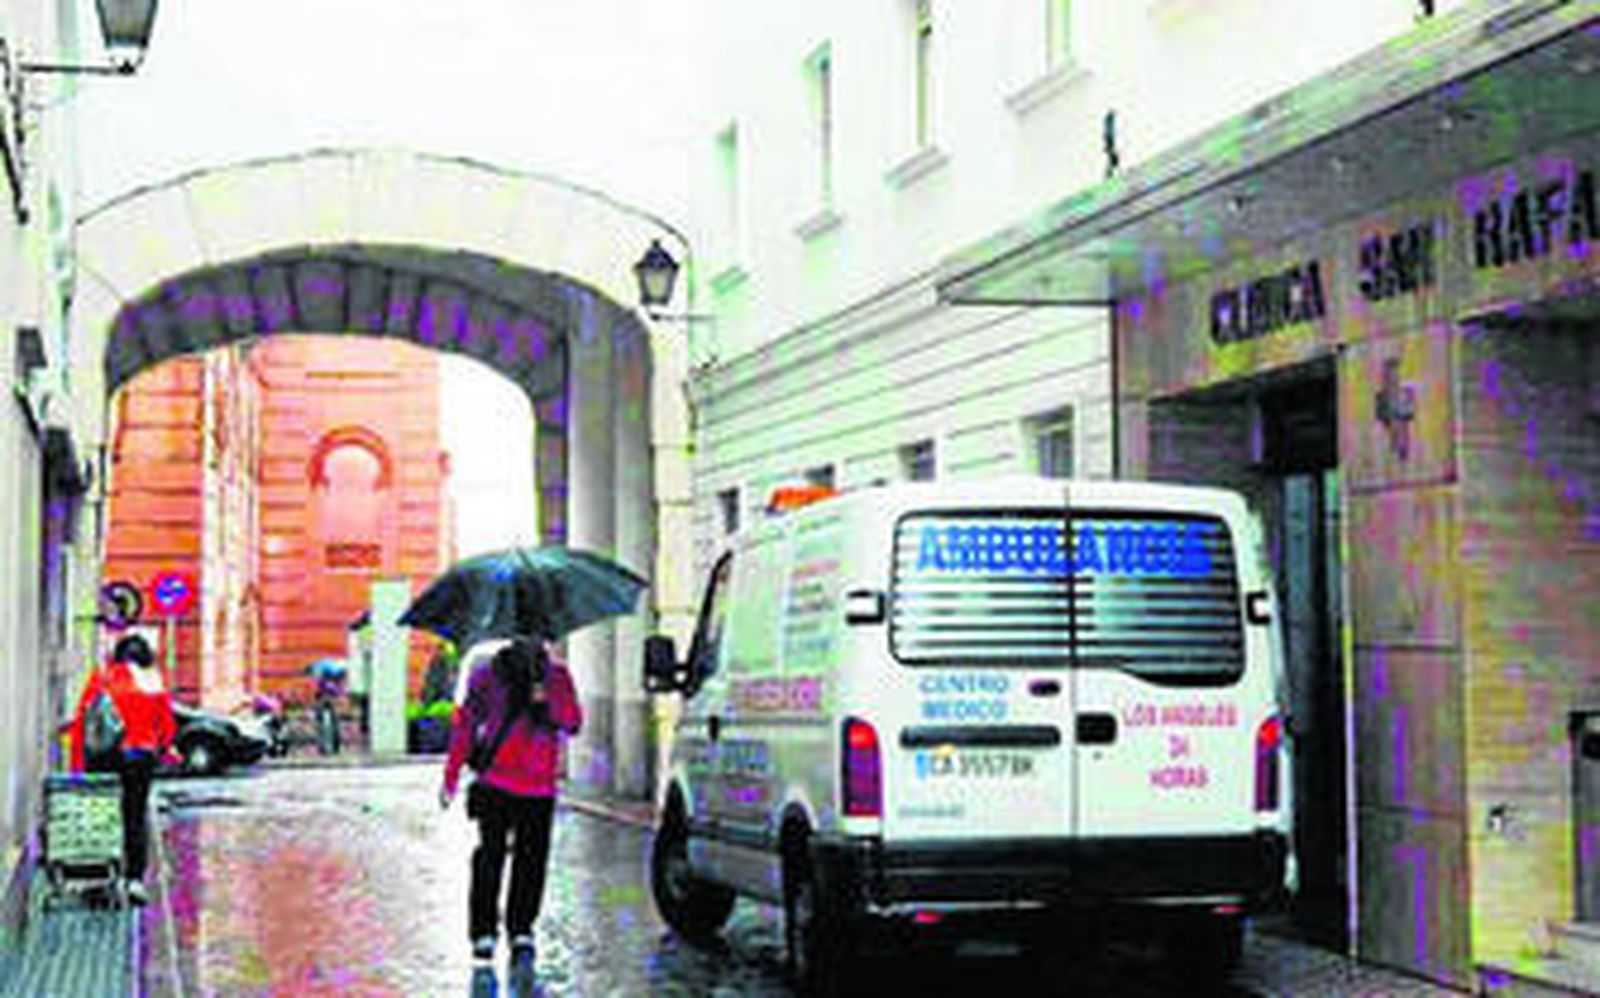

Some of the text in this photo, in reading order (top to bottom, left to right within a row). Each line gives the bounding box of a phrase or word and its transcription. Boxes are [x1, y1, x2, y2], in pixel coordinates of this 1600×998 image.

[1359, 221, 1440, 301] SAN
[916, 522, 1213, 574] AMBULANCIA
[919, 674, 1010, 694] CENTRO
[1122, 702, 1156, 727] LOS
[1148, 764, 1209, 789] HORAS
